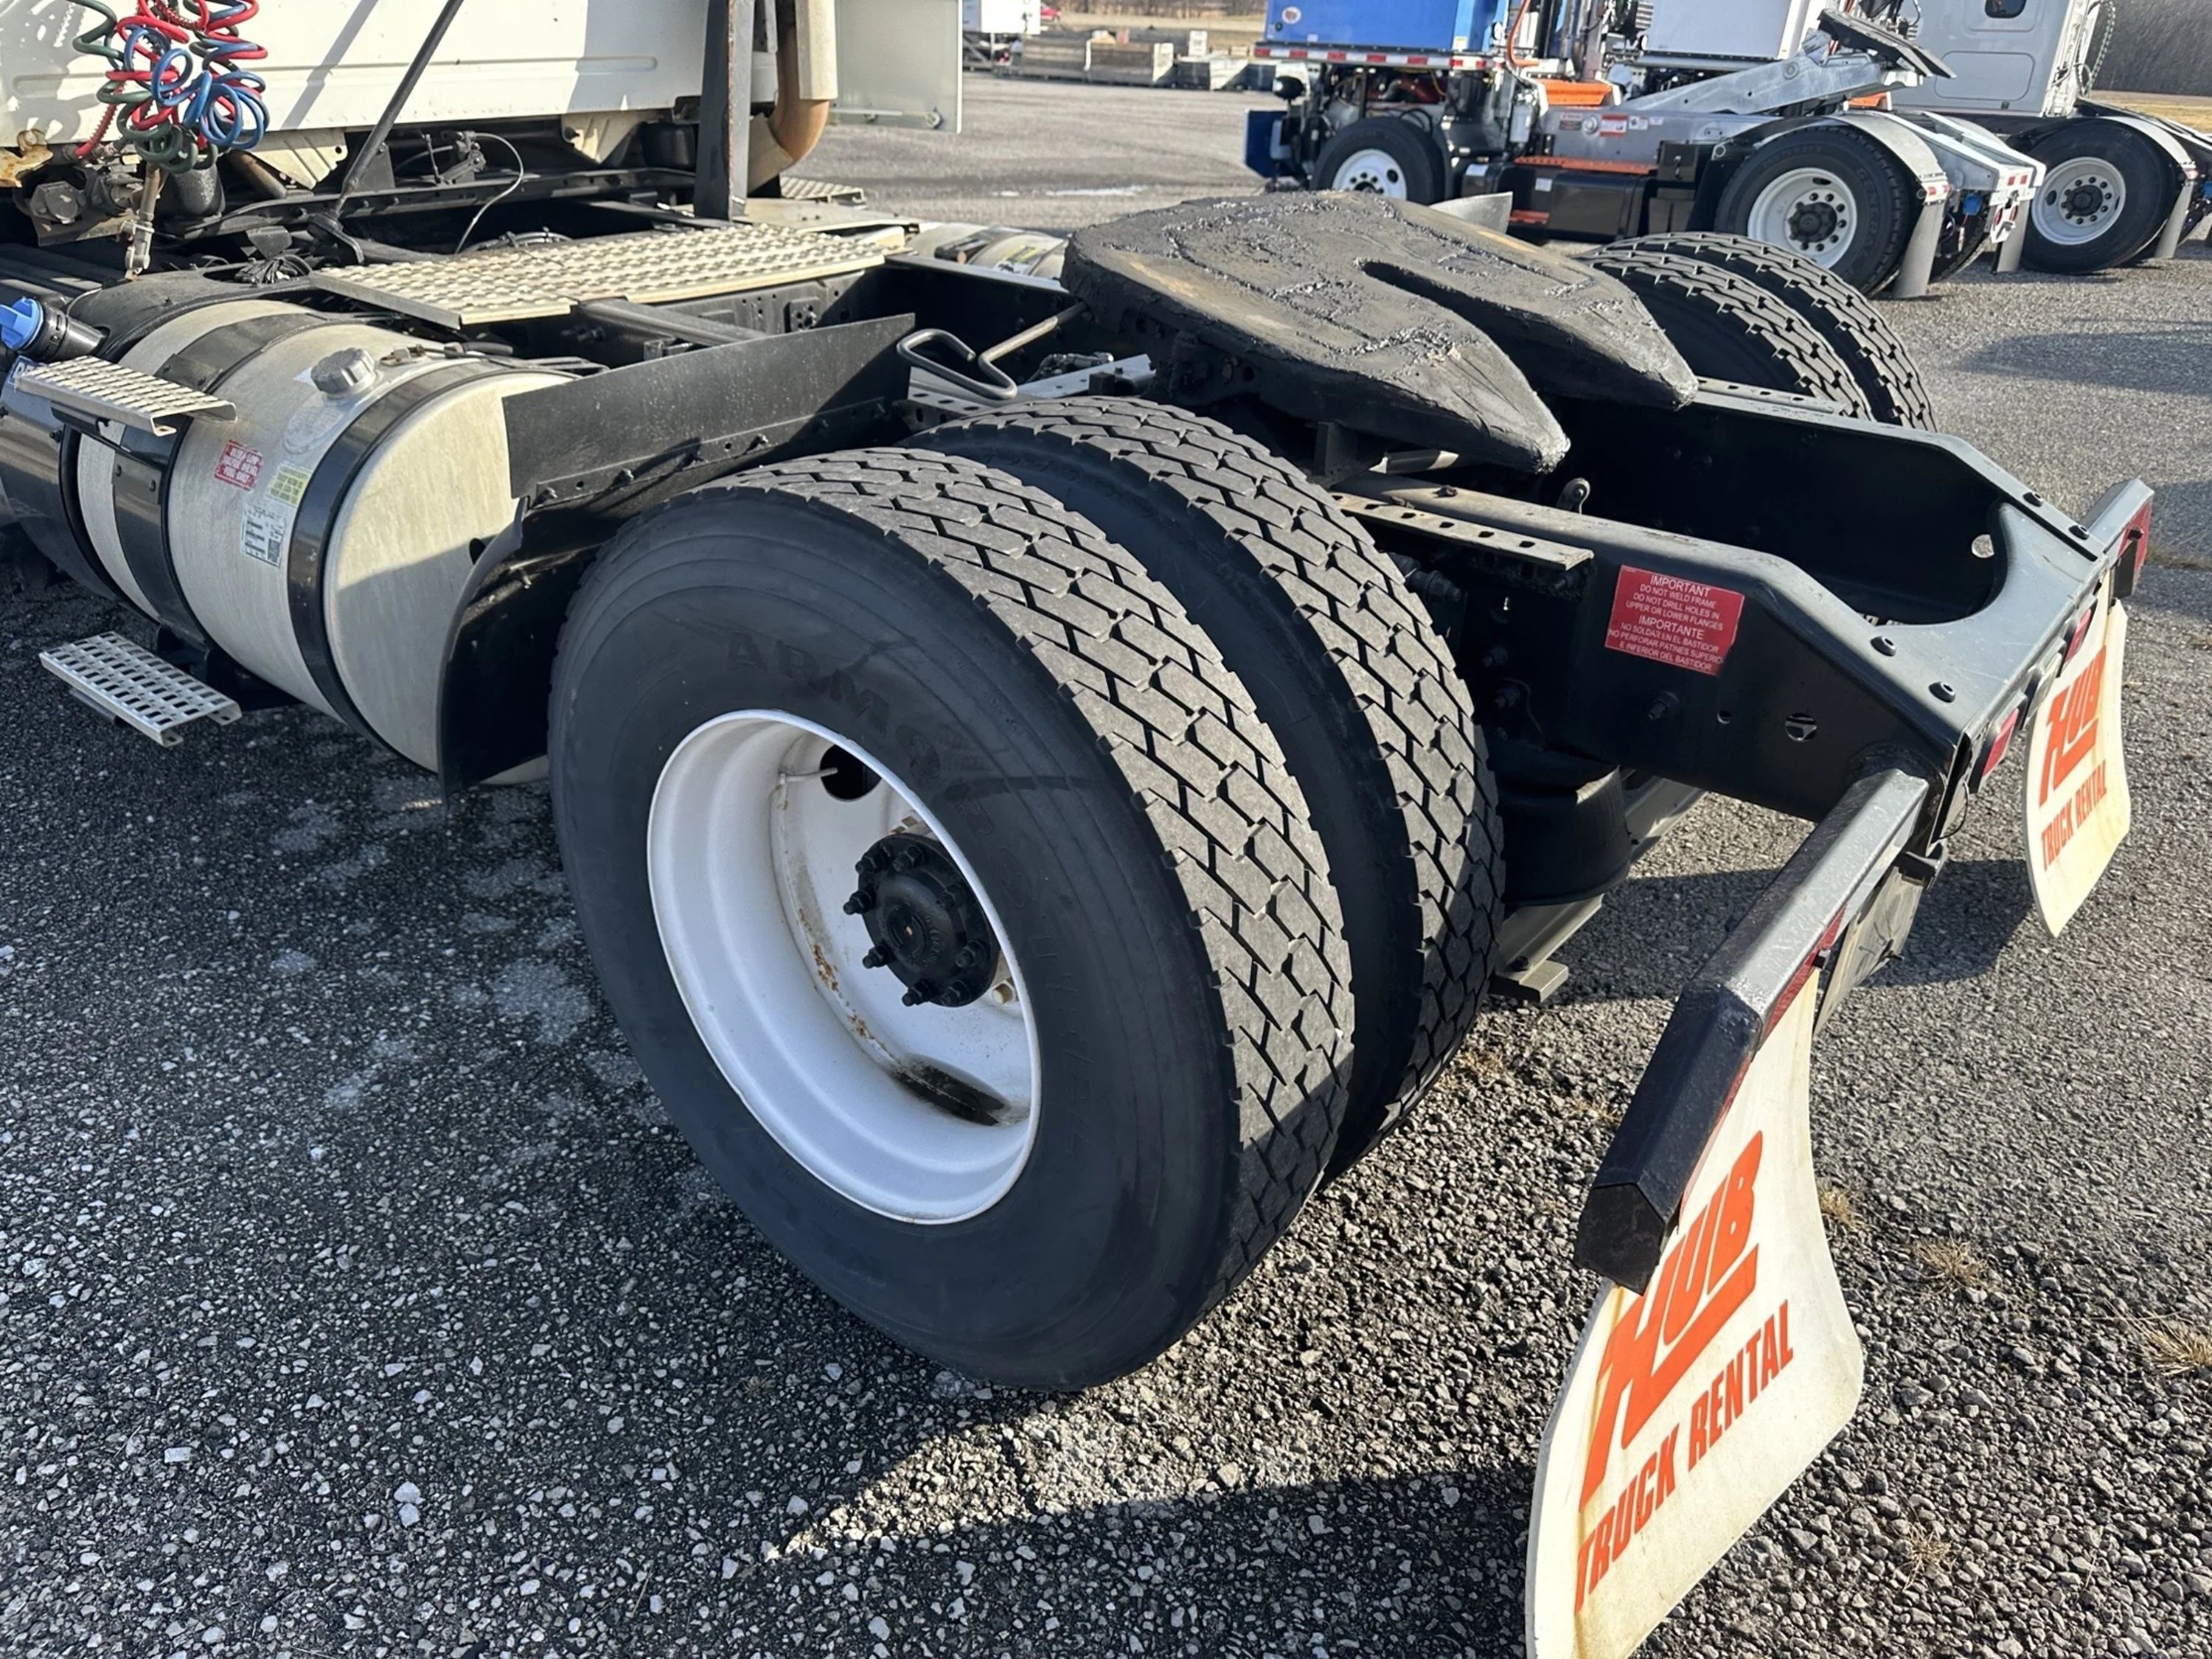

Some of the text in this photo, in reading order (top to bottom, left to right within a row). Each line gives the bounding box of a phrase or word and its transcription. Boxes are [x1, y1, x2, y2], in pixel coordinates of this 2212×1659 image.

[1640, 584, 1717, 609] DO NOT WELD FRAME
[1650, 574, 1711, 597] IMPORTANT
[1625, 600, 1724, 631] UPPER OR LOWER FLANGES
[1632, 592, 1720, 620] DO NOT DRILL HOLES IN
[1609, 629, 1620, 639] NO
[1620, 631, 1659, 647] PERFORAR
[1659, 641, 1689, 656] PATINES
[1620, 622, 1632, 632] NO
[1660, 633, 1672, 641] EN
[1672, 635, 1682, 644] EL
[1683, 638, 1720, 653] BASTIDOR
[1638, 615, 1705, 640] IMPORTANTE
[1619, 640, 1712, 671] E INFERIOR DEL BASTIDOR
[2039, 645, 2107, 809] HUB
[2041, 759, 2108, 872] TRUCK RENTAL
[1579, 1130, 1764, 1513] HUB
[1574, 1298, 1794, 1617] TRUCK RENTAL
